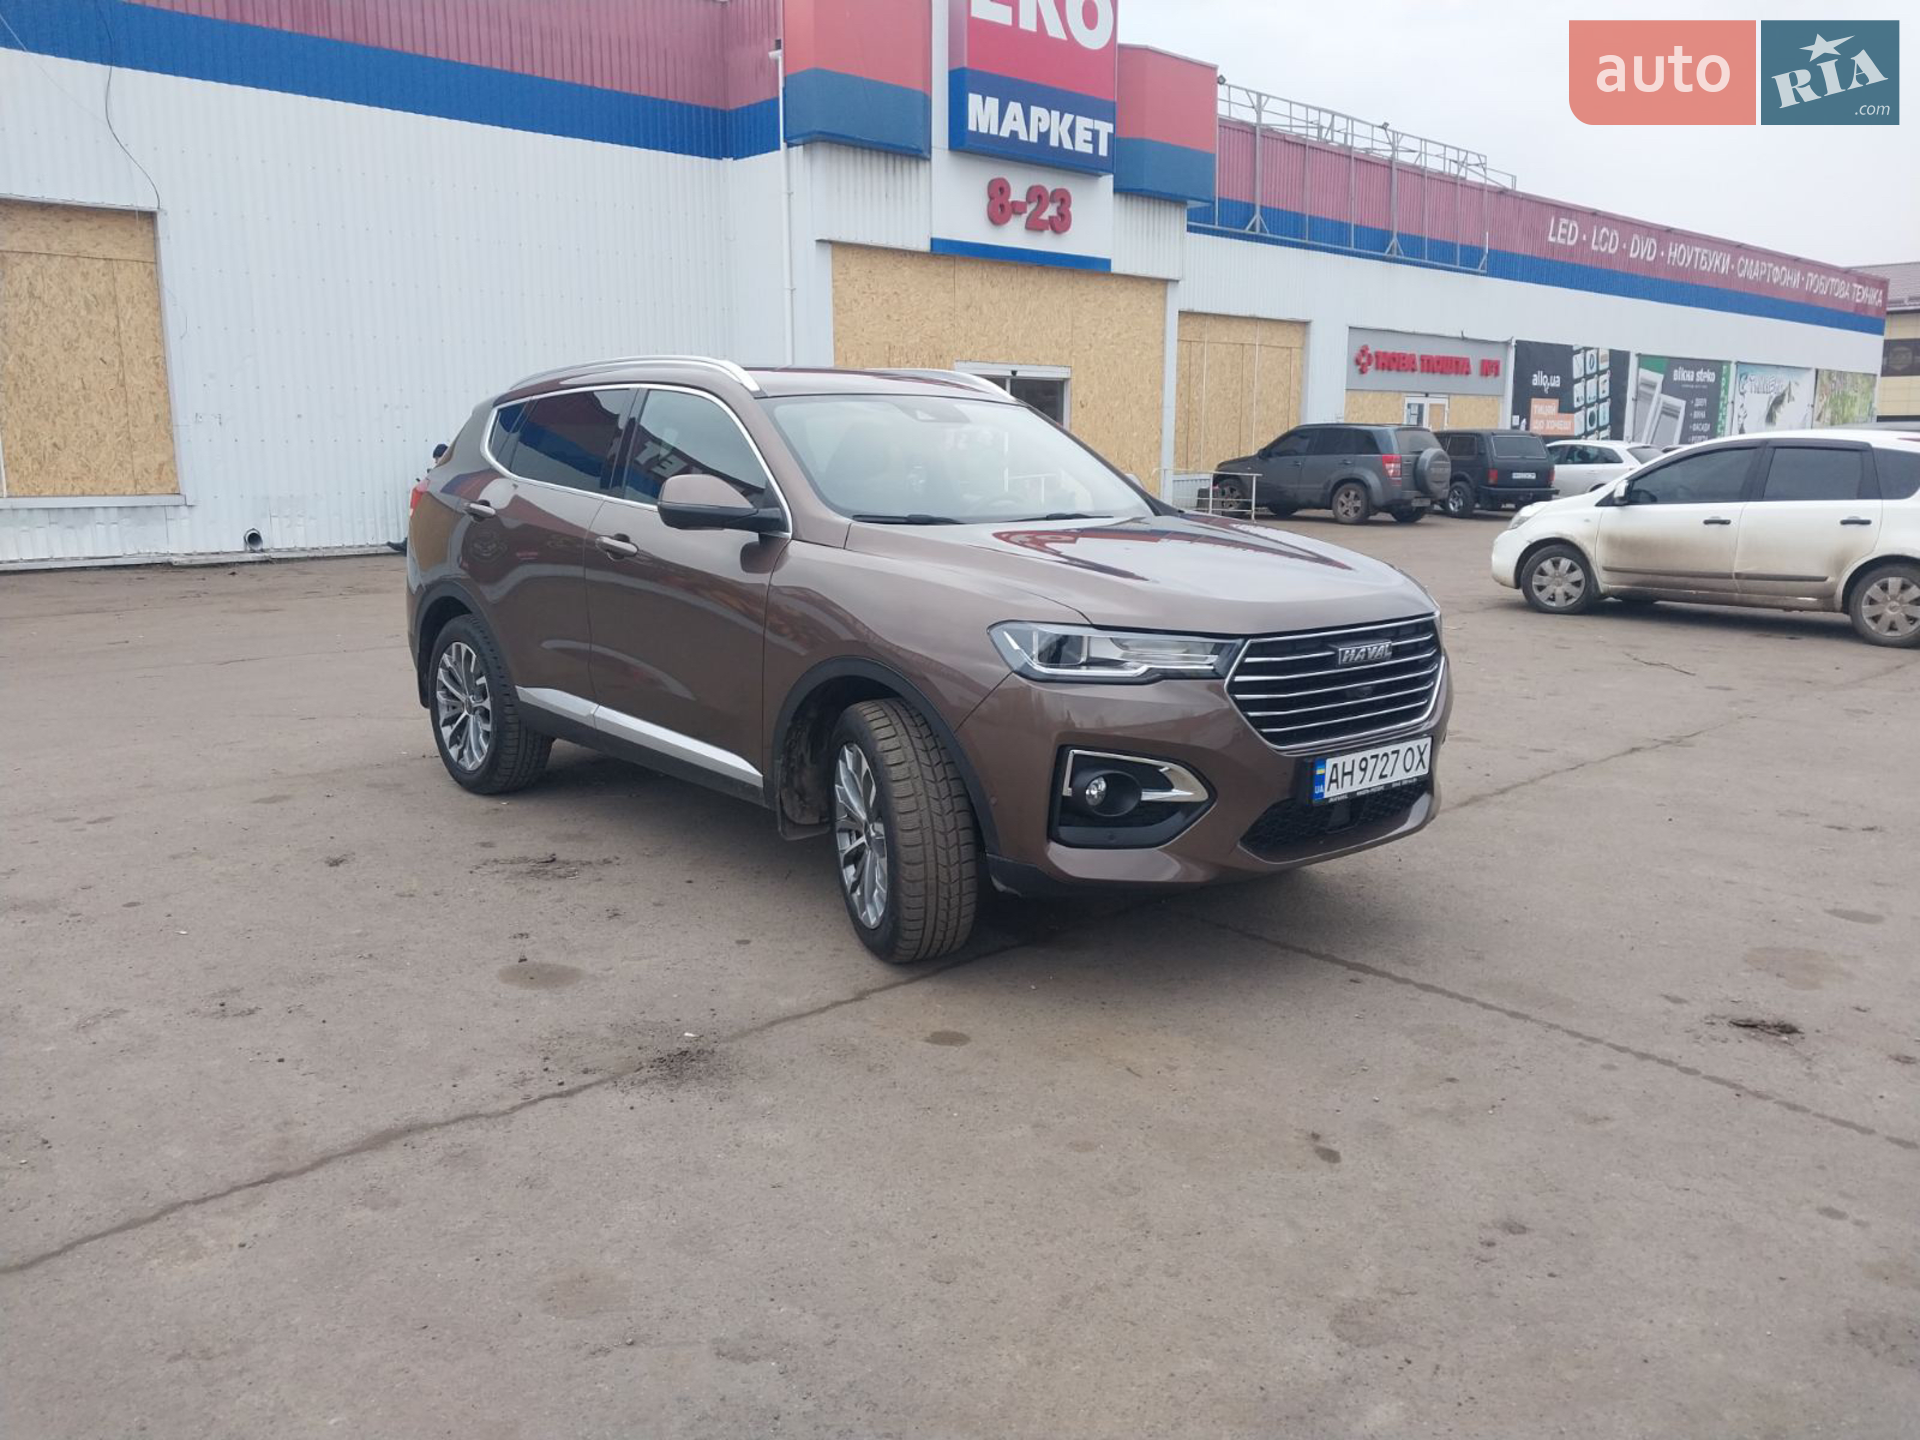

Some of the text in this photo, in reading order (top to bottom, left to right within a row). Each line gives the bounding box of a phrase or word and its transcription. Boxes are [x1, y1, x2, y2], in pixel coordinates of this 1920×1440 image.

[968, 92, 1114, 157] МАРКЕТ
[987, 177, 1073, 234] 8-23
[1548, 216, 1579, 246] LED
[1591, 225, 1620, 254] LCD
[1630, 234, 1657, 261] DVD
[1667, 242, 1731, 275] НОУТБУКИ
[1737, 256, 1801, 289] СМАРТФОНИ
[1805, 272, 1850, 299] ПОБУТОВА
[1342, 643, 1392, 662] HAVAL
